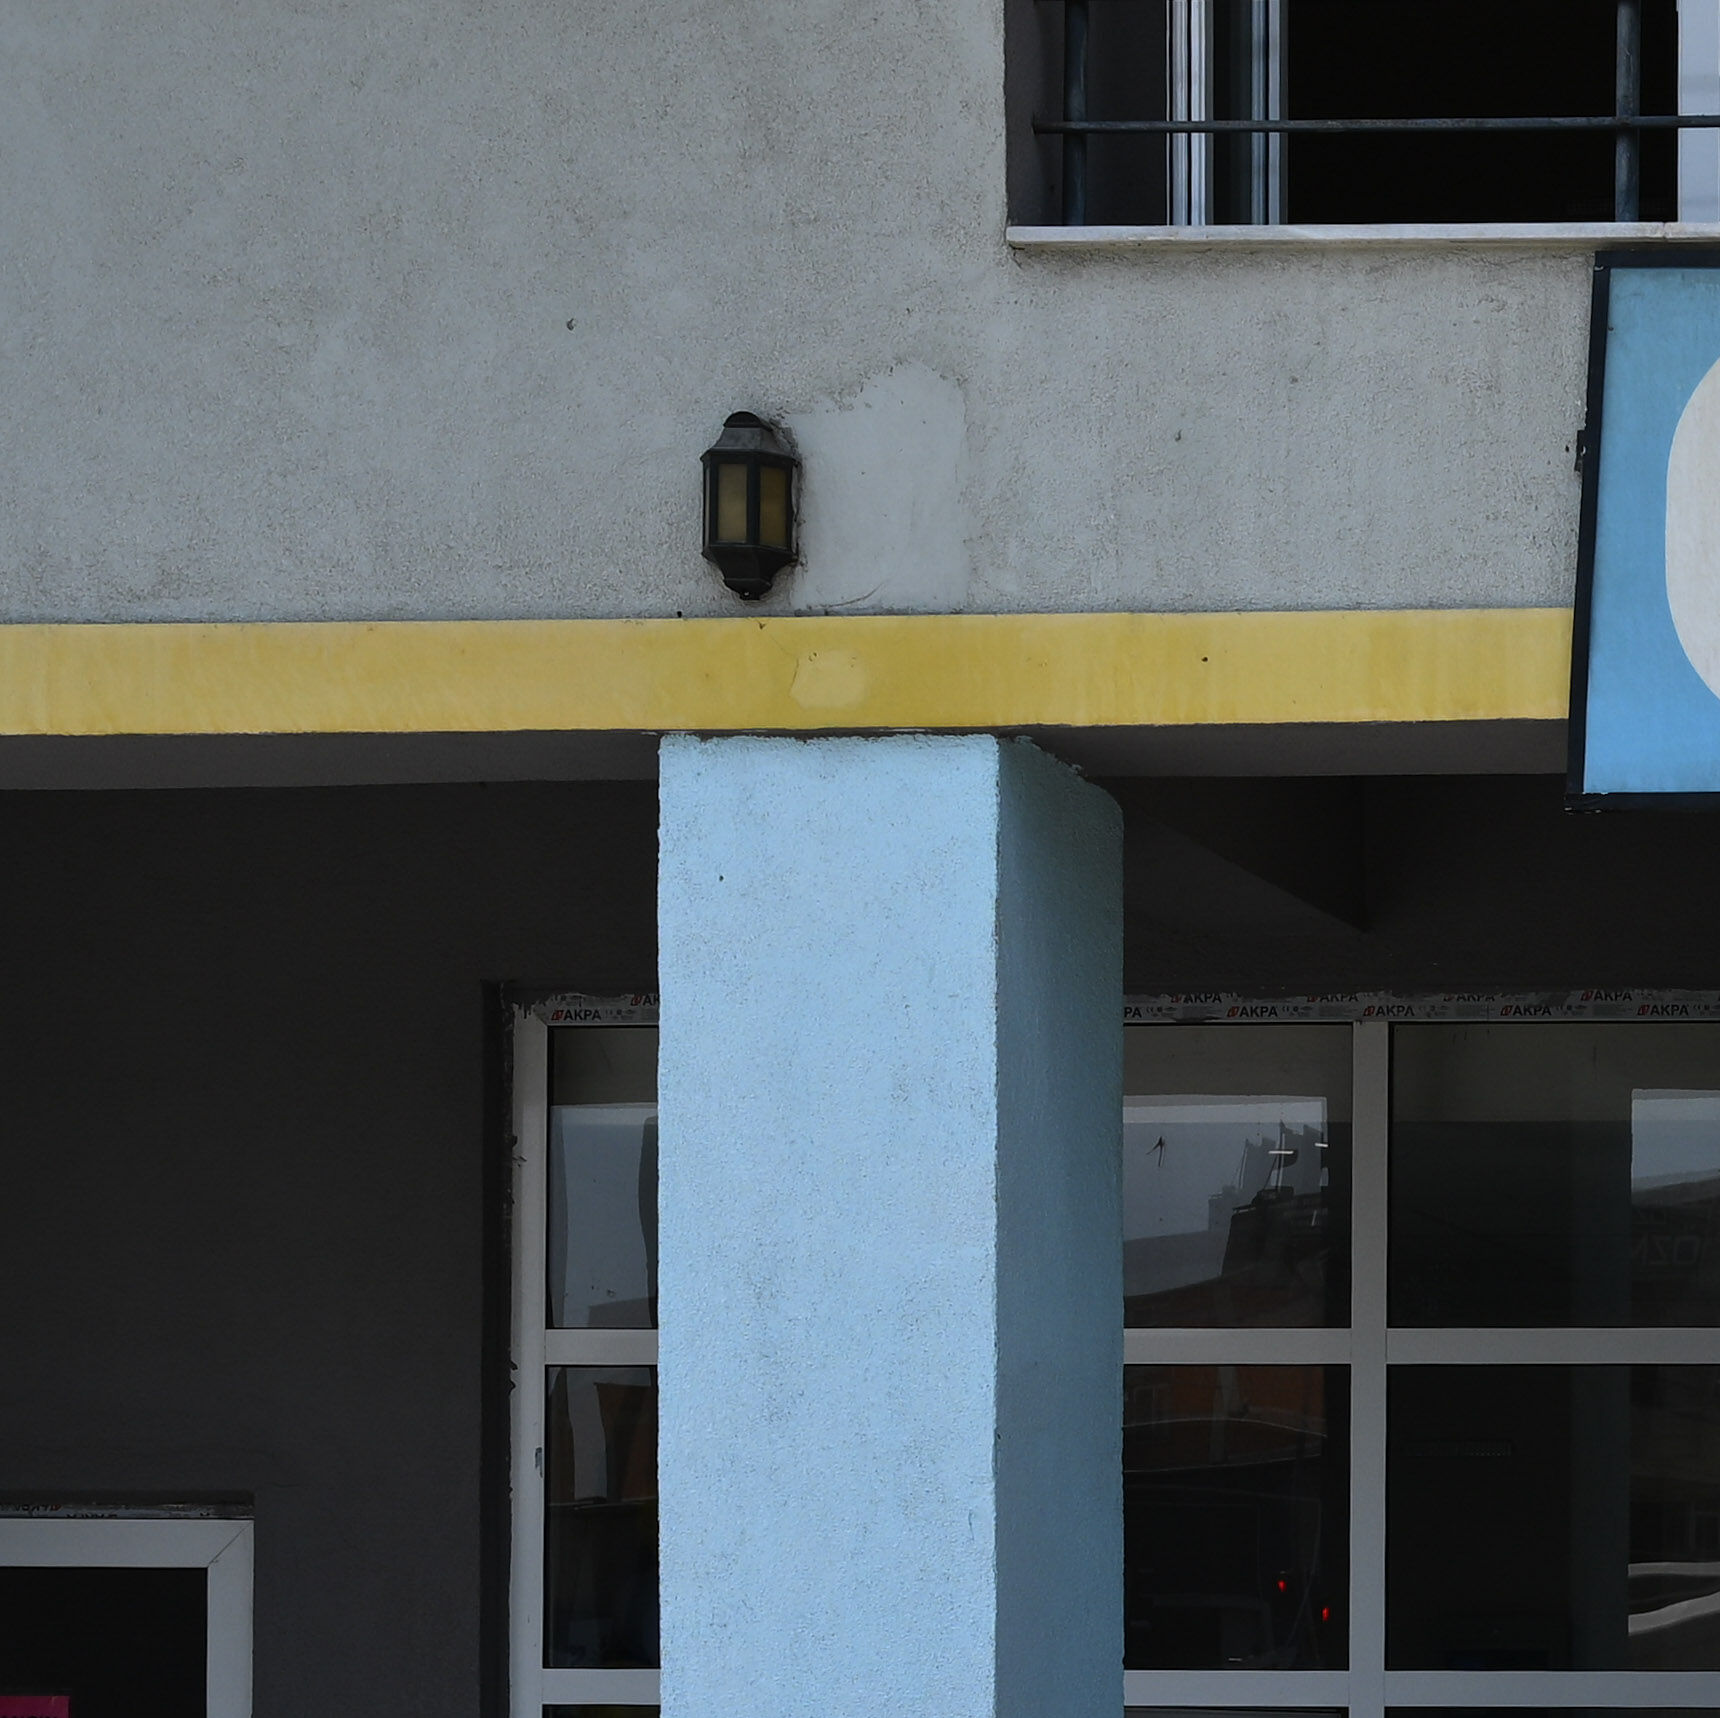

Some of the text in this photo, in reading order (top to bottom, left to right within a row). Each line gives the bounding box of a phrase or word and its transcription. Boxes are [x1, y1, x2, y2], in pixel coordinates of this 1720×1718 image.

[563, 1009, 602, 1021] AKPA
[1238, 1007, 1278, 1018] AKPA
[1649, 1005, 1689, 1016] AKPA
